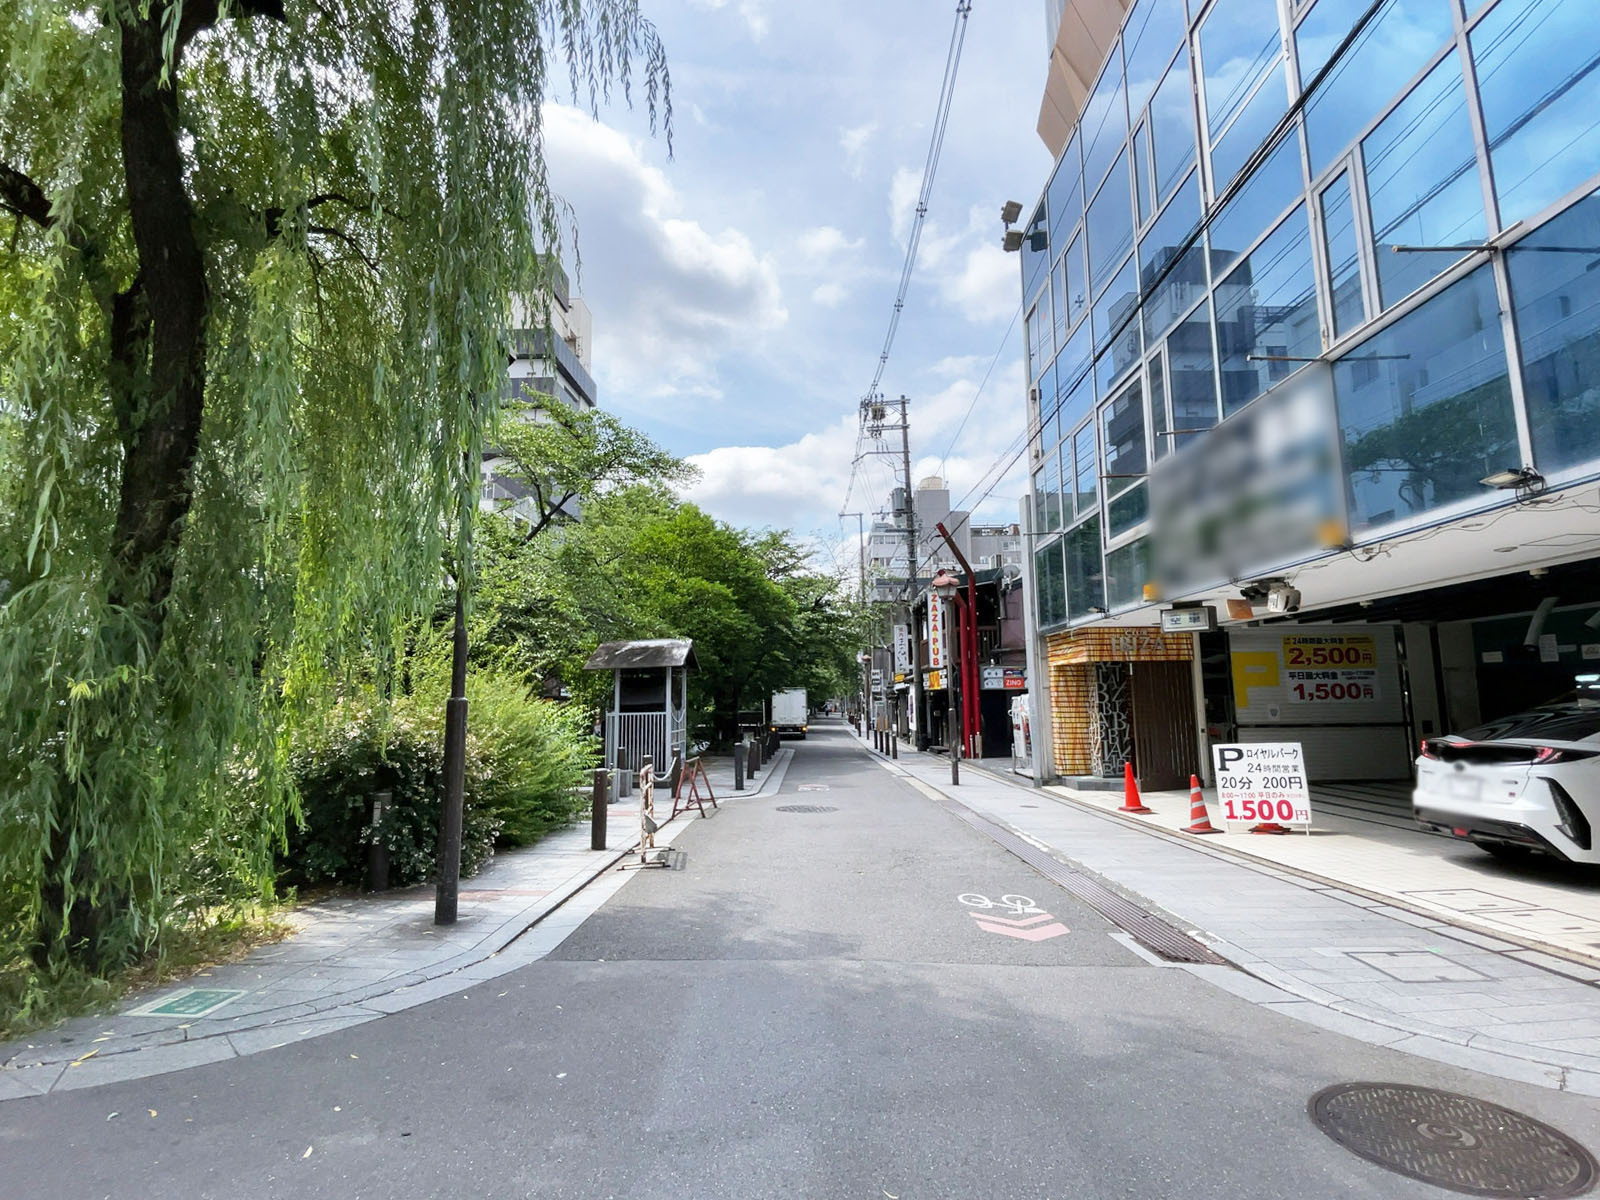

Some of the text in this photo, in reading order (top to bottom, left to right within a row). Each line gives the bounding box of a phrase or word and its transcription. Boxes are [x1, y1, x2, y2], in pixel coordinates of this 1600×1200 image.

[1218, 748, 1244, 772] P
[1247, 763, 1300, 774] 24時間営業
[1221, 776, 1303, 790] 20分 200円
